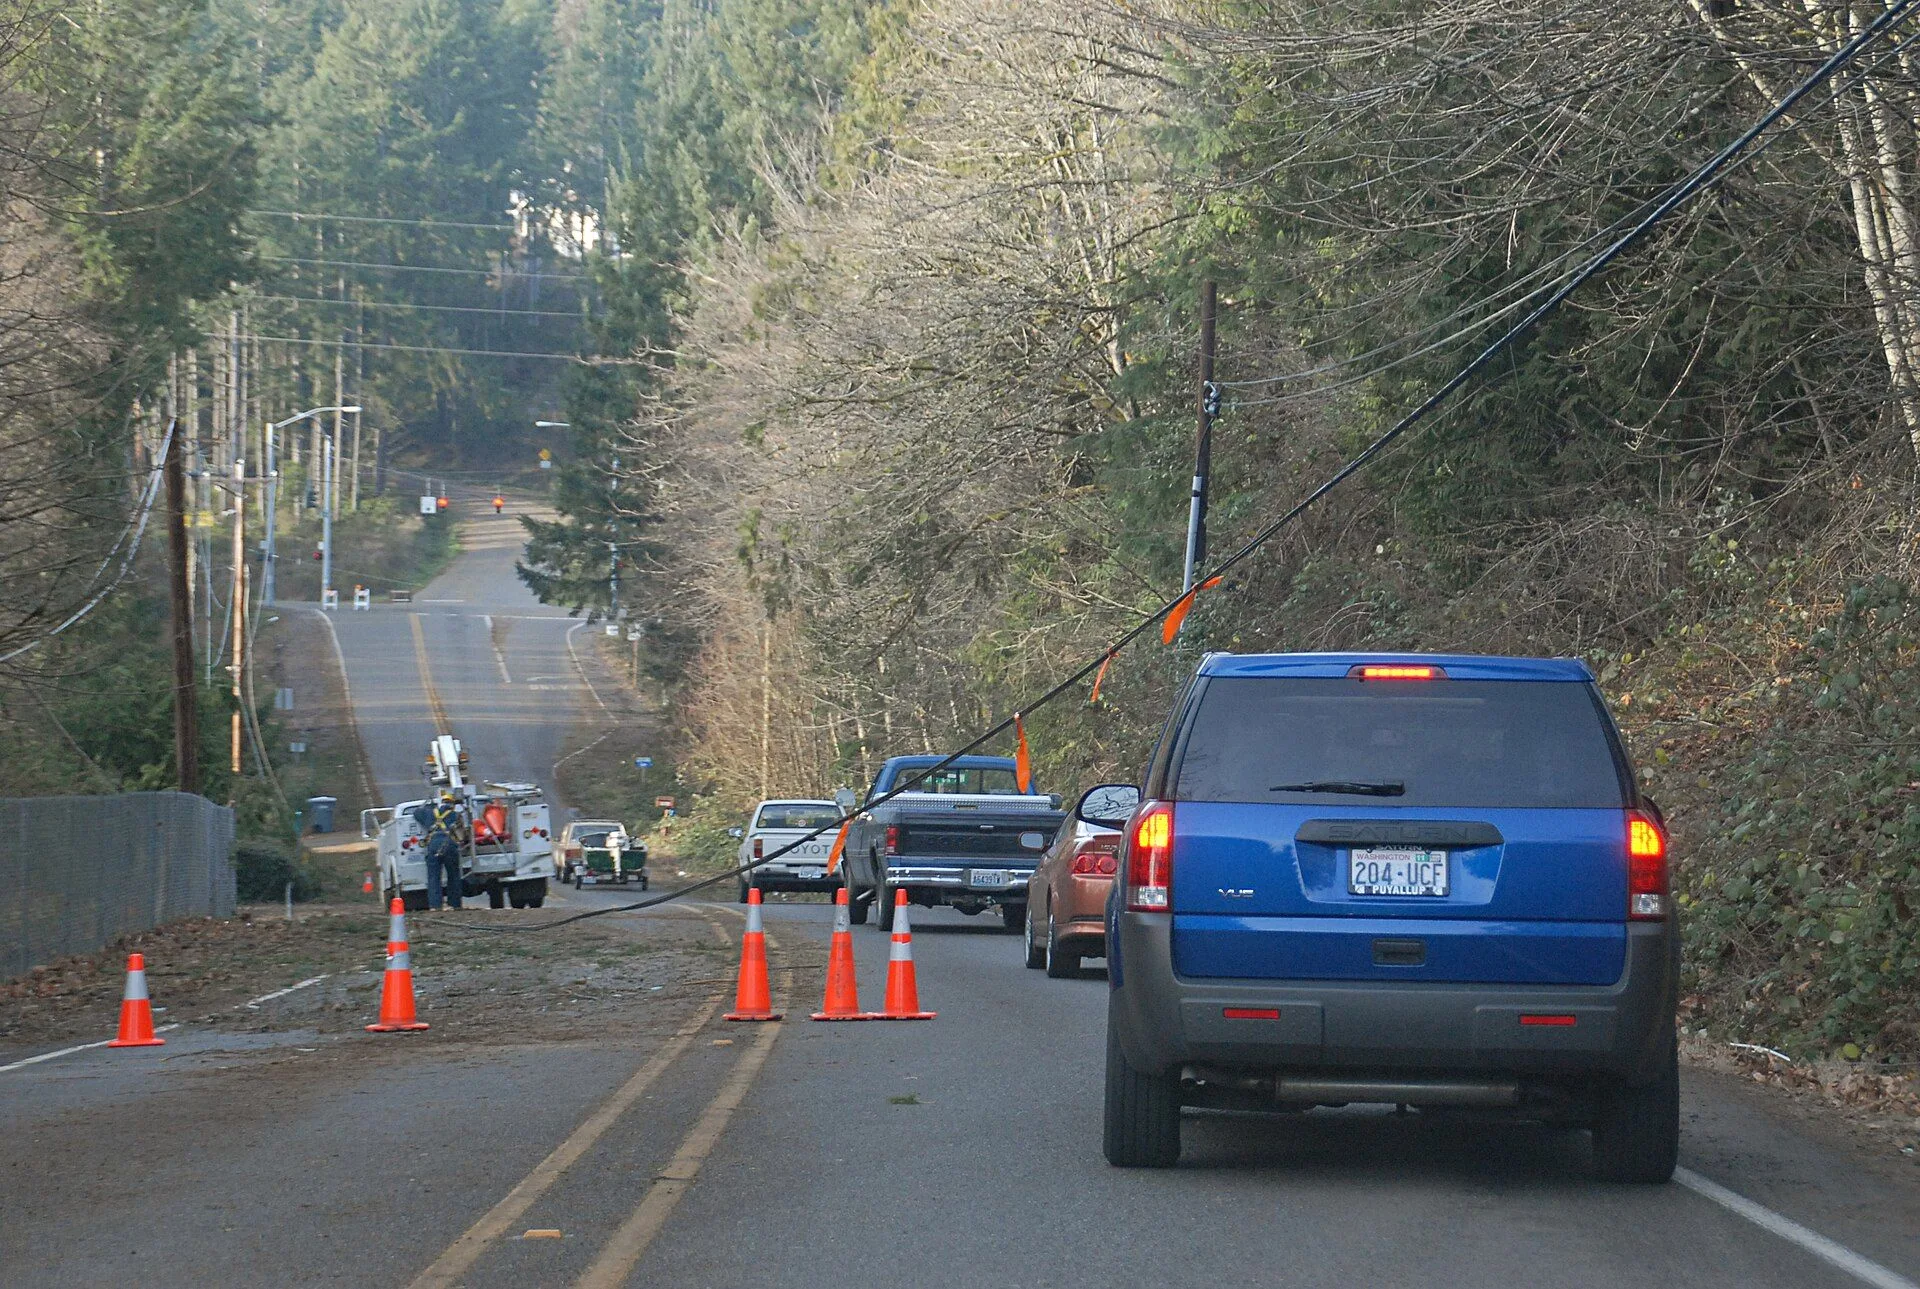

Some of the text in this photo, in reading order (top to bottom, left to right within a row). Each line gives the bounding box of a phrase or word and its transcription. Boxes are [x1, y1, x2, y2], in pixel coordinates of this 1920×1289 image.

[1328, 825, 1469, 840] SATURN
[780, 844, 832, 854] OYOT
[1356, 853, 1411, 861] WASHINGTON
[1218, 888, 1254, 898] VUE
[1372, 885, 1426, 895] PUYALLUP
